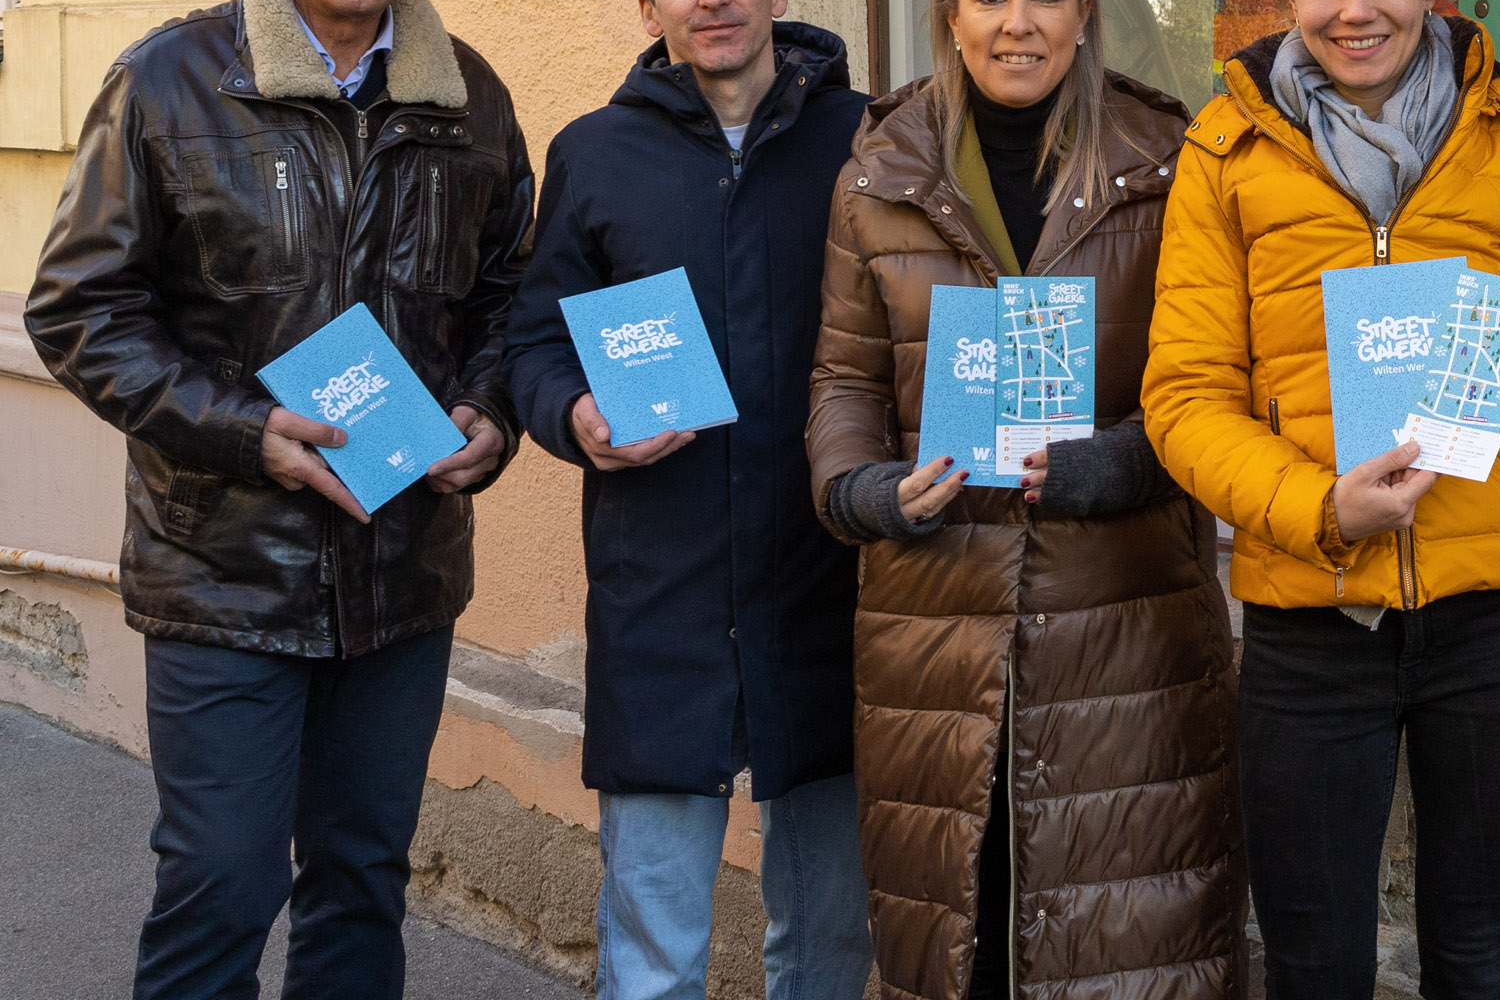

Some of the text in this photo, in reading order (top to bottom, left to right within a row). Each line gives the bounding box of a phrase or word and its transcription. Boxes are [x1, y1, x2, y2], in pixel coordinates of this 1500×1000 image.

[1048, 282, 1084, 295] STREET
[1048, 293, 1086, 304] GALERIE
[601, 318, 670, 345] STREET
[1356, 316, 1437, 342] STREET
[606, 332, 683, 360] GALERIE
[623, 352, 674, 368] Wilten West
[1373, 364, 1405, 376] Wilten
[312, 362, 372, 405] STREET
[965, 386, 994, 396] Wilten
[322, 374, 390, 422] GALERIE
[344, 396, 388, 428] Wilten West
